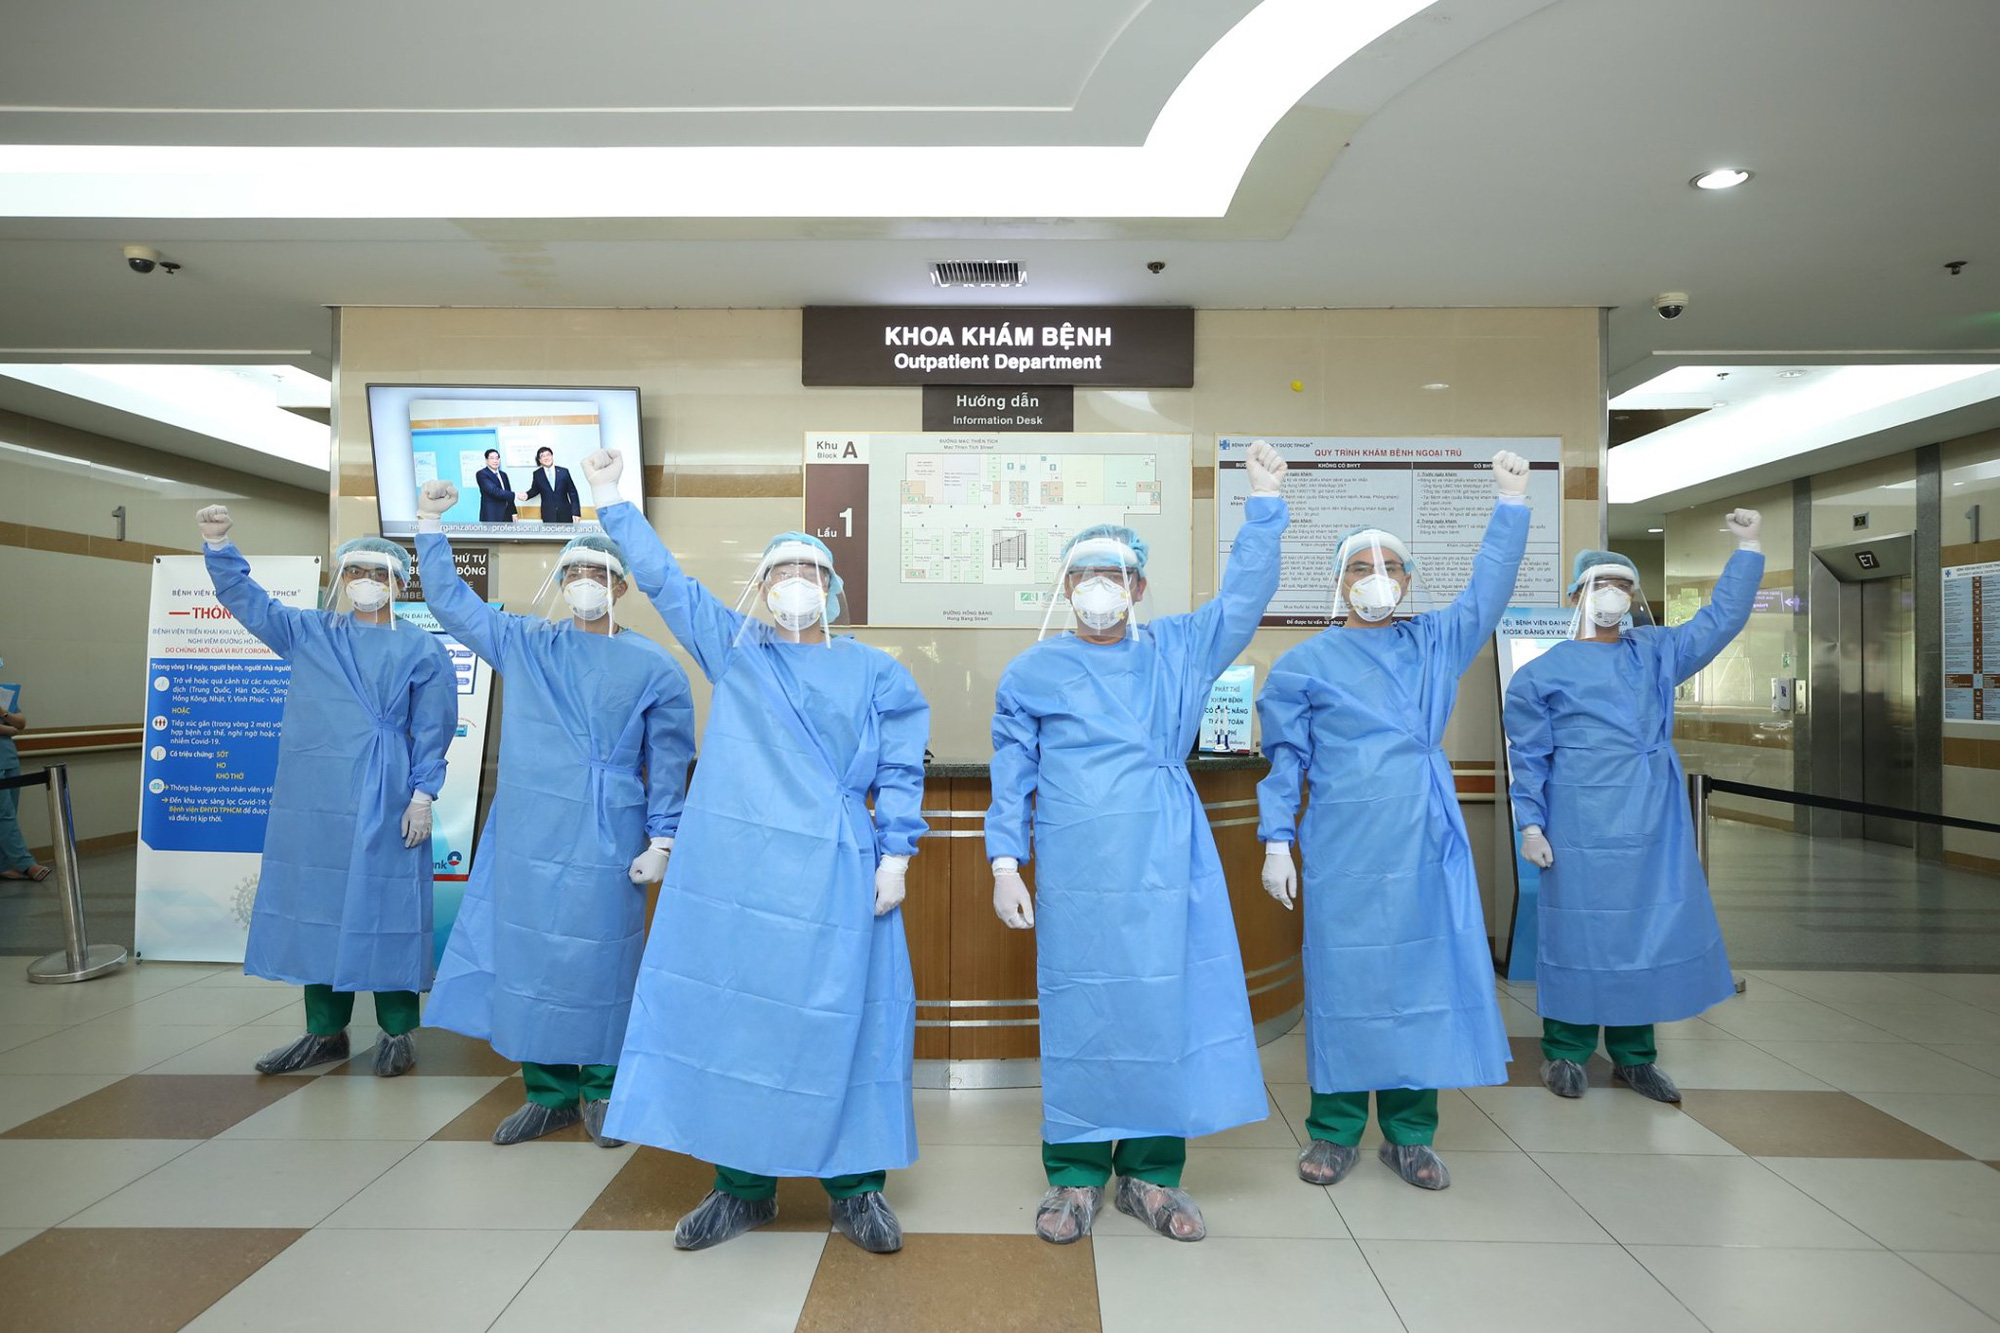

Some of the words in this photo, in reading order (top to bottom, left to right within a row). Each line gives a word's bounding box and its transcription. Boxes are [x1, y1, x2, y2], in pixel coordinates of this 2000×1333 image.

[885, 327, 954, 346] KHOA
[961, 322, 1034, 347] KHÁM
[1042, 322, 1112, 350] BỆNH
[894, 353, 989, 372] Outpatient
[994, 354, 1102, 373] Department
[956, 393, 1006, 410] Hướng
[1010, 392, 1039, 407] dẫn
[953, 416, 1014, 425] Information
[1016, 416, 1043, 425] Desk
[817, 441, 838, 450] Khu
[842, 441, 858, 458] A
[1314, 449, 1333, 457] QUY
[1335, 447, 1360, 456] TRÌNH
[1363, 447, 1388, 456] KHÁM
[1390, 447, 1413, 457] BỆNH
[1416, 449, 1443, 457] NGOẠI
[839, 508, 853, 537] 1
[441, 524, 488, 535] rganizations,
[492, 524, 540, 535] professional
[542, 525, 575, 534] societies
[577, 524, 593, 533] and
[452, 552, 471, 563] HỨ
[472, 553, 487, 565] TỰ
[1858, 554, 1874, 567] E7
[456, 565, 487, 577] ĐỘNG
[192, 605, 232, 619] THÔN
[173, 686, 186, 694] dịch
[189, 686, 210, 694] (Trung
[274, 686, 288, 695] Sing
[172, 707, 191, 715] HOẶC
[1231, 706, 1249, 714] NĂNG
[172, 719, 185, 727] Tiếp
[211, 720, 231, 729] (trong
[232, 721, 249, 729] vòng
[185, 729, 201, 737] bệnh
[228, 730, 242, 738] nghi
[171, 784, 188, 792] Thông
